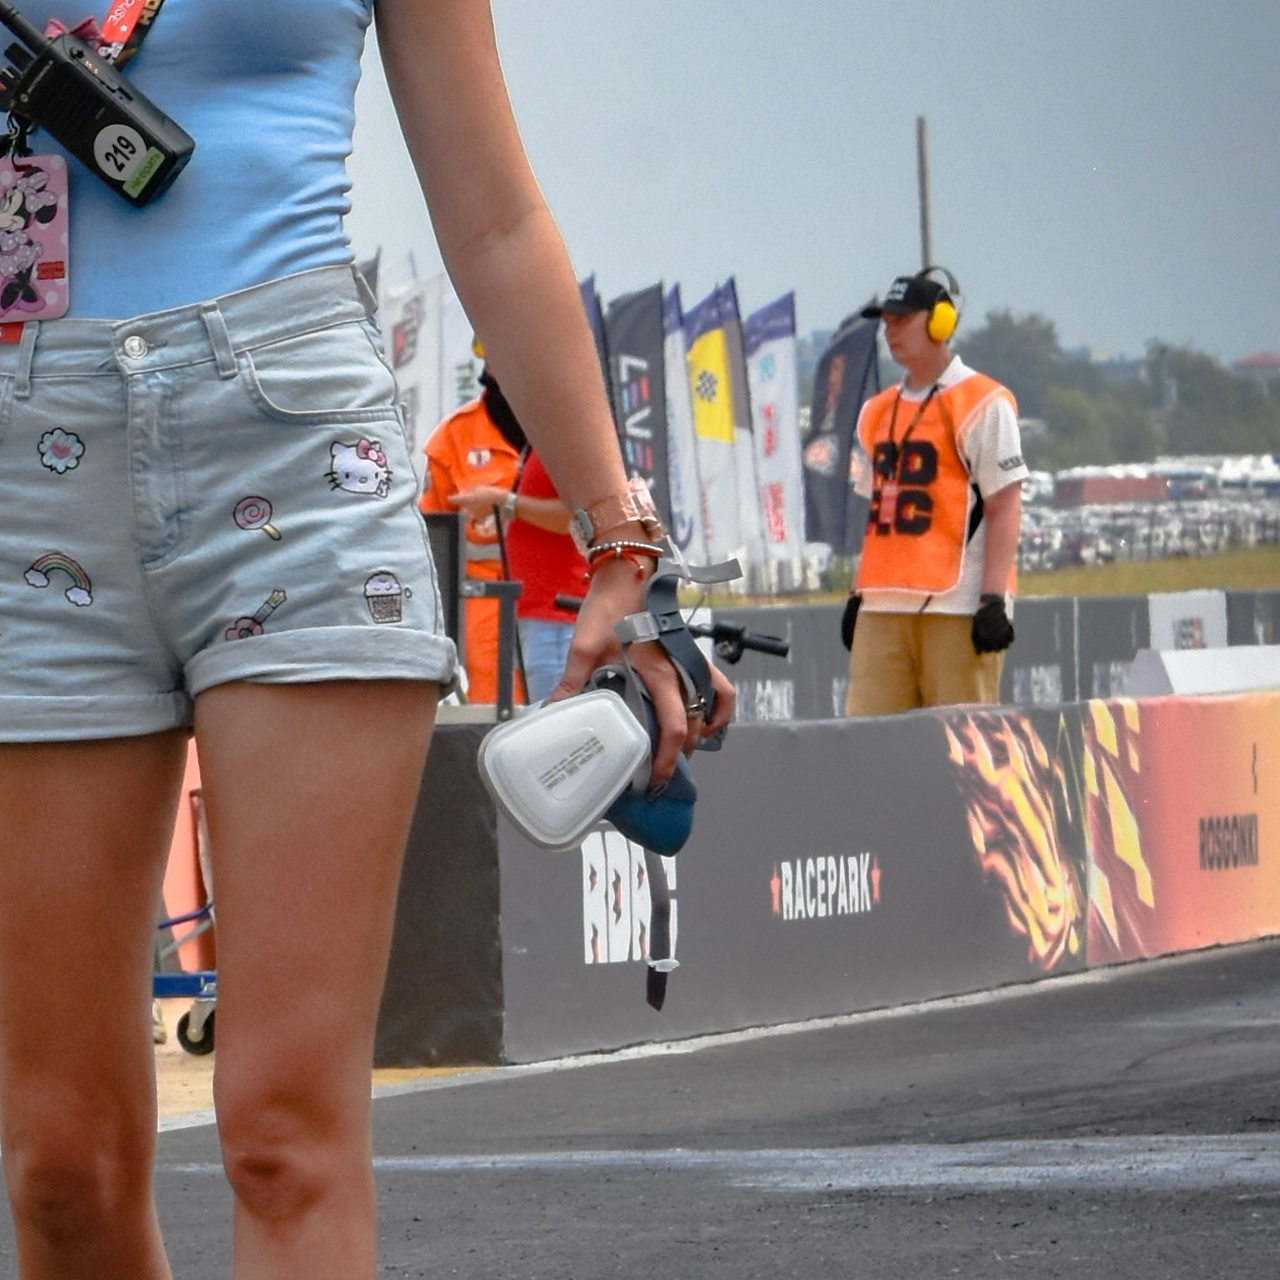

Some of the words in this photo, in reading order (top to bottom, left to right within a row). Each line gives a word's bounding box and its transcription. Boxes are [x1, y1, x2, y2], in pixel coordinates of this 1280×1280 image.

[104, 135, 136, 172] 219
[580, 831, 678, 964] RDR
[780, 852, 871, 920] RACEPARK
